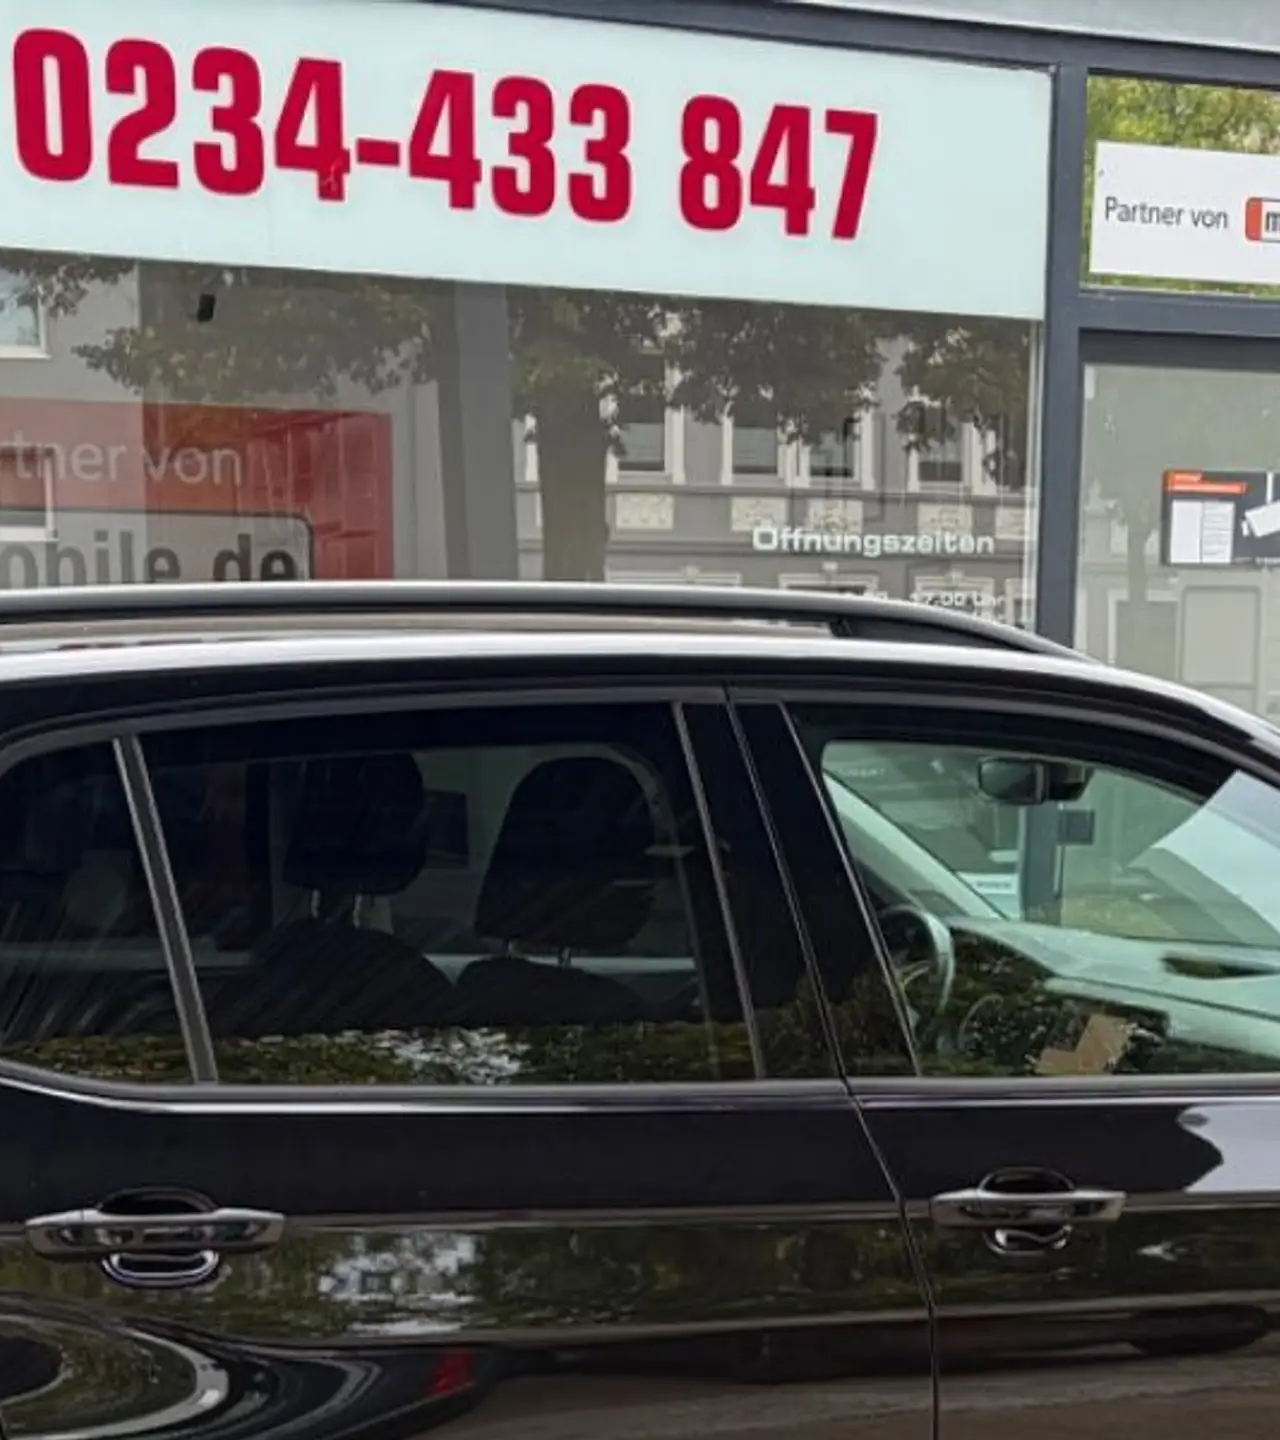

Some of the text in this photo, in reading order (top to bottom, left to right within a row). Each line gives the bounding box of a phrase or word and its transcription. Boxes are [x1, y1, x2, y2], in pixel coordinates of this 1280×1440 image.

[12, 28, 632, 223] 0234-433
[678, 95, 878, 240] 847
[1104, 196, 1183, 227] Partner
[1191, 206, 1228, 230] von
[142, 443, 243, 486] von
